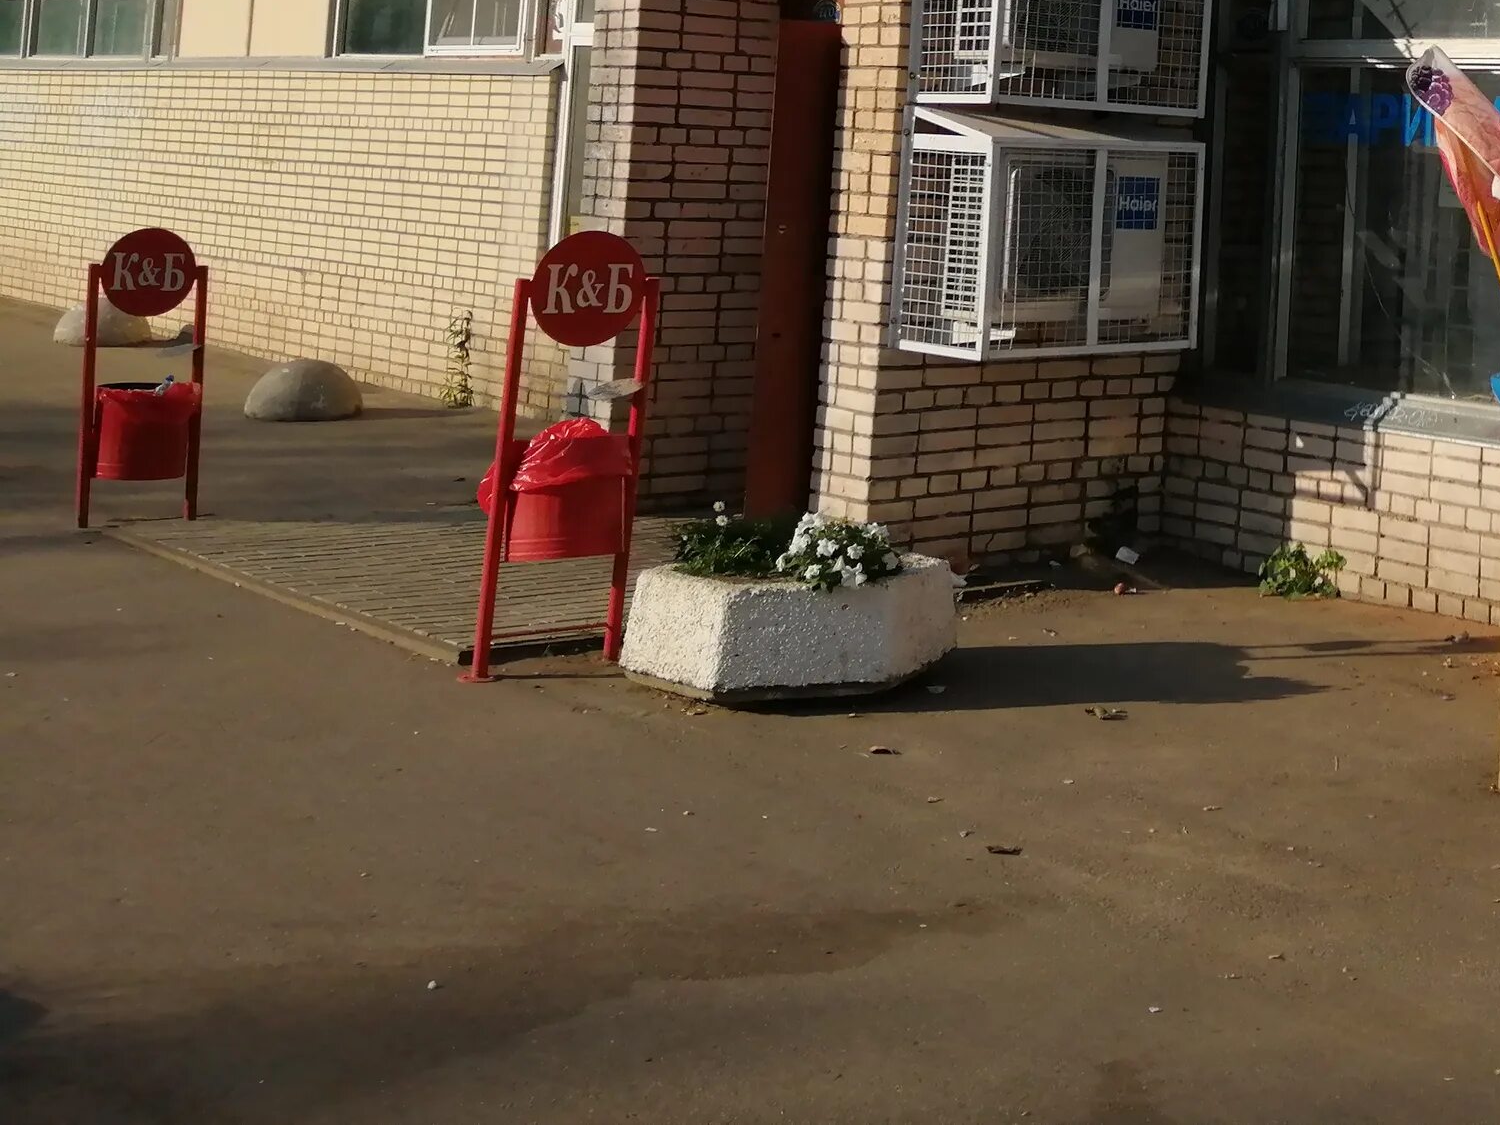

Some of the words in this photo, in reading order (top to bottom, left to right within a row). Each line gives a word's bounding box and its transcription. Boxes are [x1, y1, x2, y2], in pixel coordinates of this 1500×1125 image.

[1119, 195, 1158, 213] Haier
[110, 252, 186, 292] К&Б
[542, 263, 634, 314] К&Б
